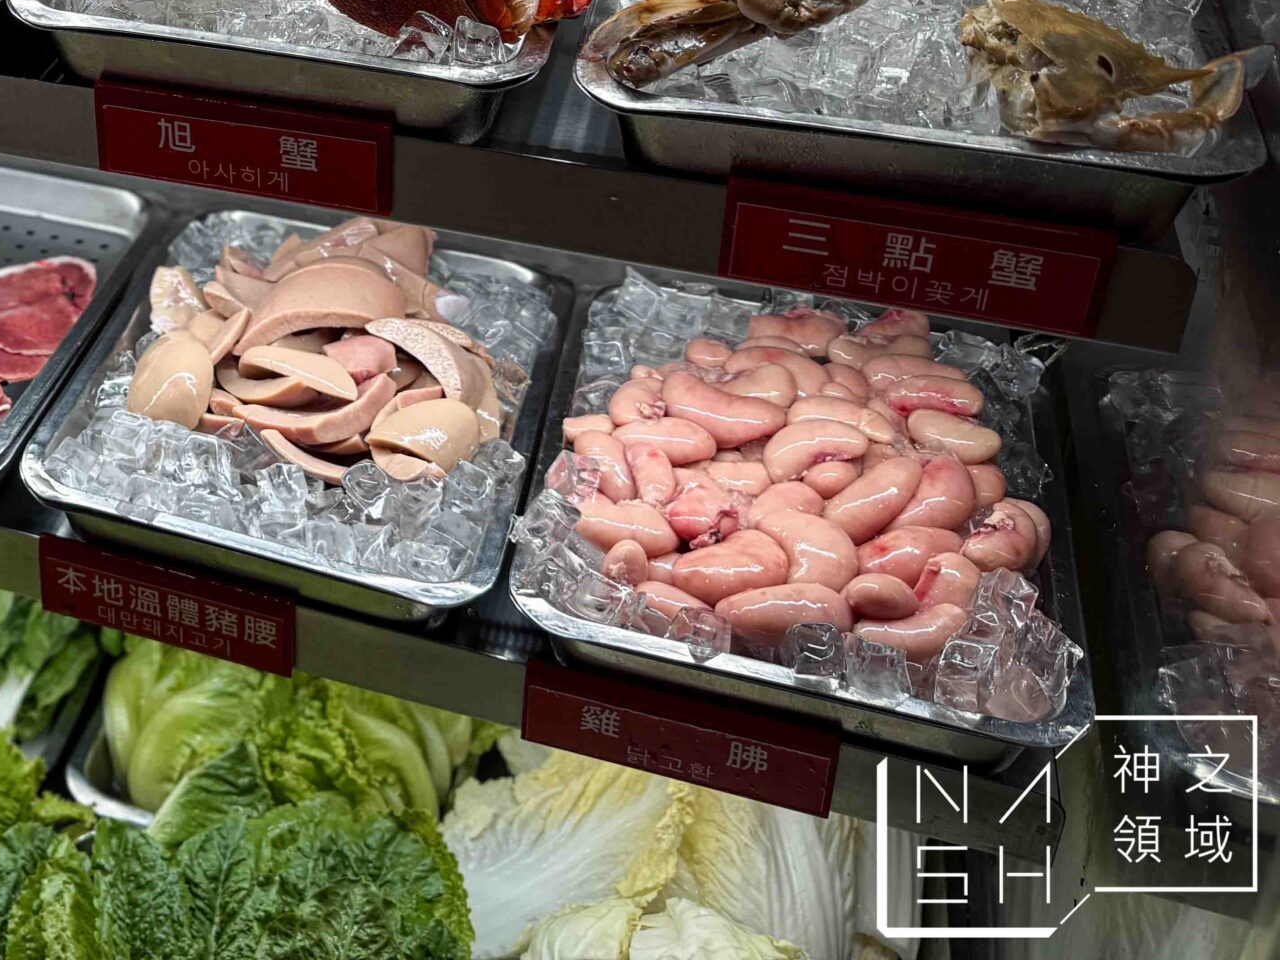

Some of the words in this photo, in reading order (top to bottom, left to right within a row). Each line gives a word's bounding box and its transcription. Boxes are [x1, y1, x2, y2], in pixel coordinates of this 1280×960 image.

[158, 117, 318, 173] 旭蟹
[188, 159, 289, 193] 아사히게
[782, 218, 1044, 291] 三點蟹
[821, 263, 989, 311] 점박이꽃게
[55, 566, 278, 649] 本地溫體豬腰
[97, 605, 231, 657] 대만돼지고기
